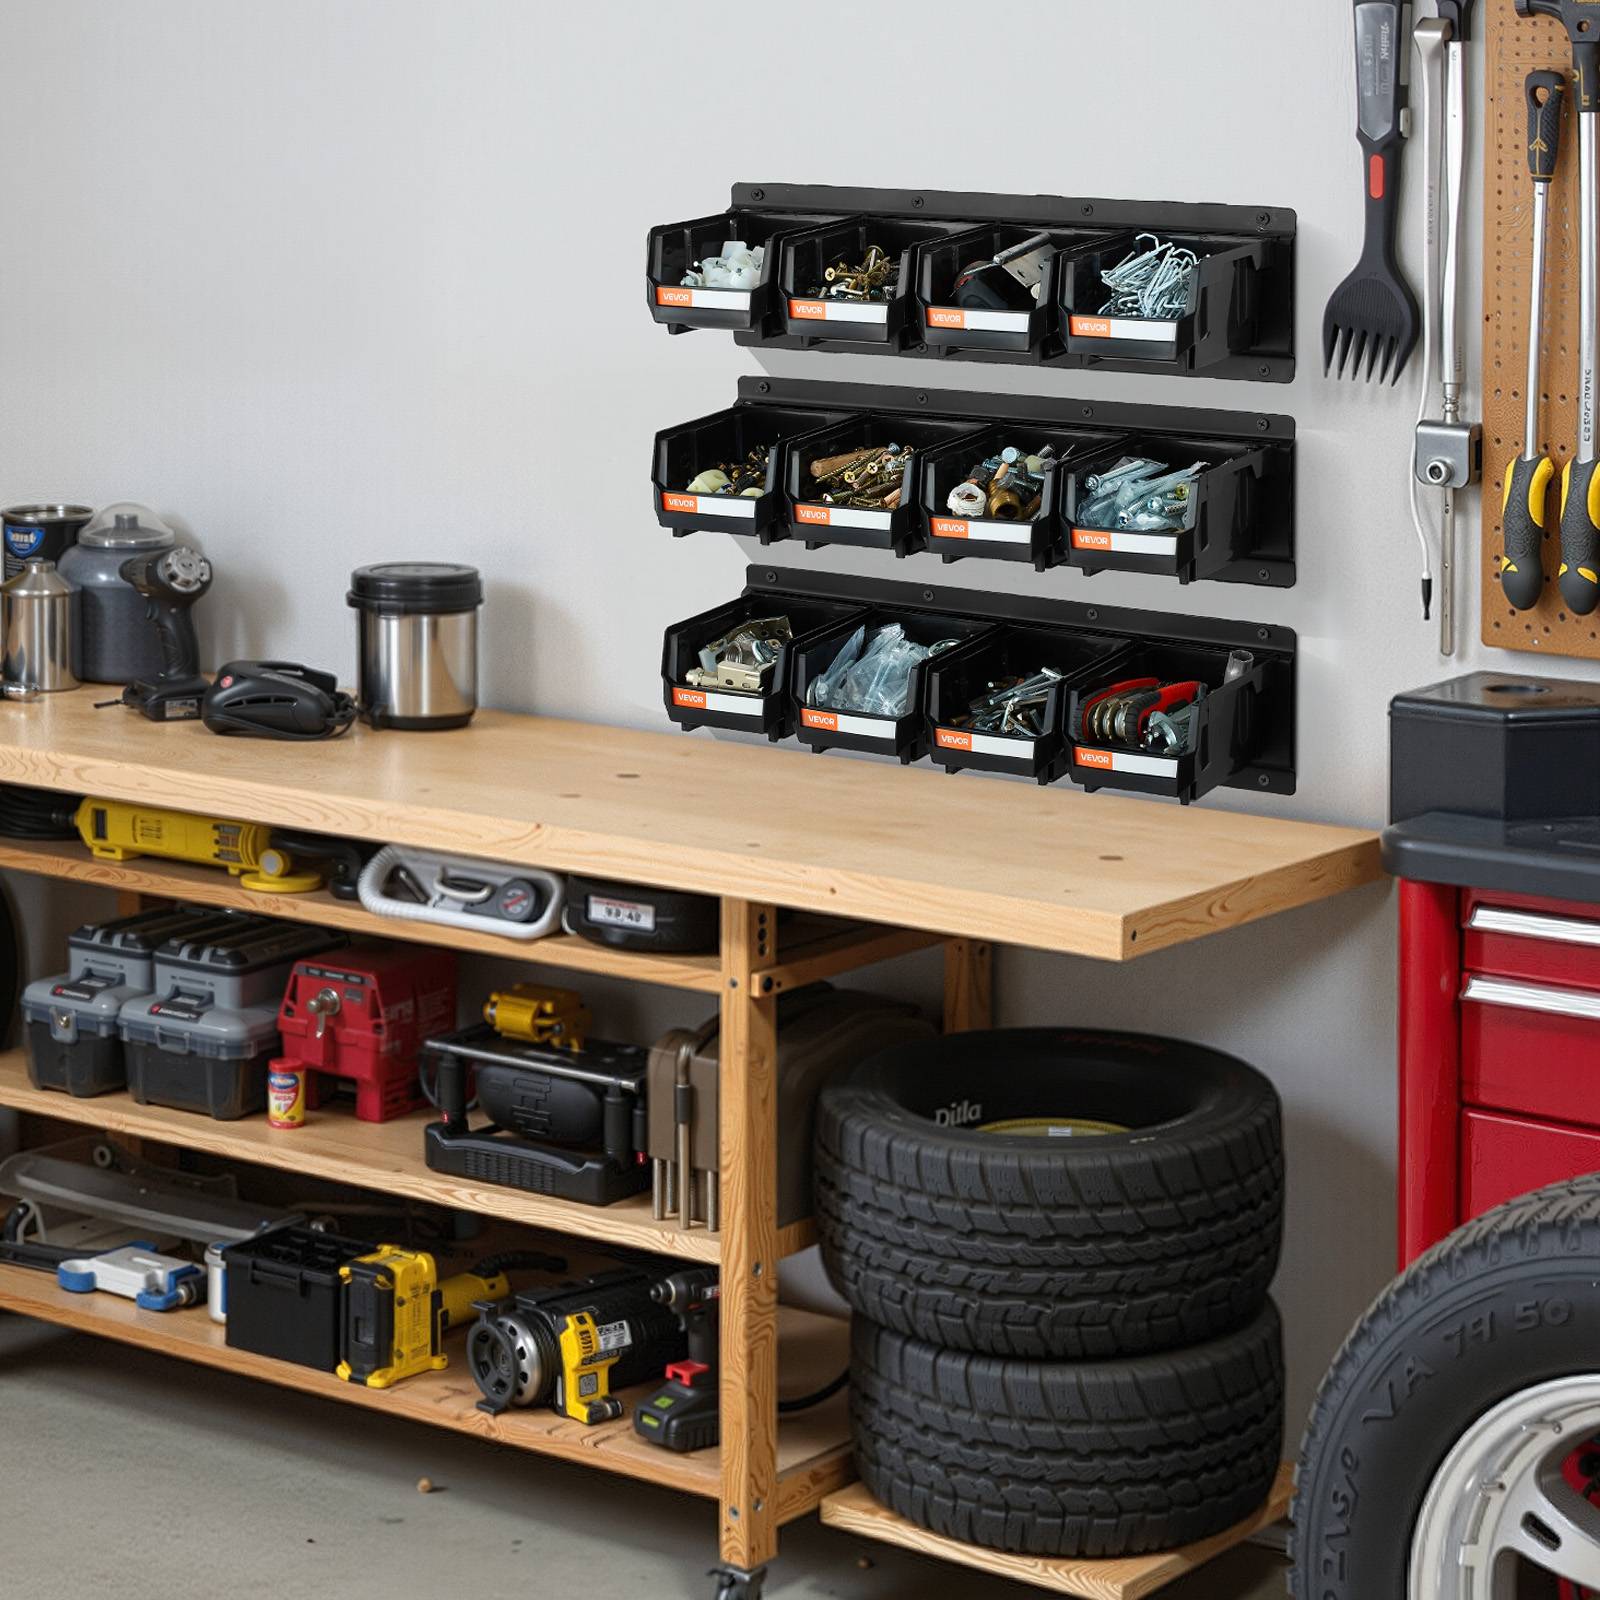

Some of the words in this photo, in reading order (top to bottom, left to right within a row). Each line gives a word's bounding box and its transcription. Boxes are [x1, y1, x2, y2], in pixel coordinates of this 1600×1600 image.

[663, 292, 689, 302] VEVOR
[796, 305, 823, 314] VEVOR
[932, 313, 961, 323] VEVOR
[1078, 322, 1107, 333] VEVOR
[668, 498, 695, 508] VEVOR
[800, 510, 827, 520] VEVOR
[937, 523, 966, 533] VEVOR
[1079, 535, 1109, 545] VEVOR
[678, 693, 705, 704] VEVOR
[808, 715, 835, 726] VEVOR
[941, 735, 969, 746] VEVOR
[1080, 753, 1110, 764] VEVOR
